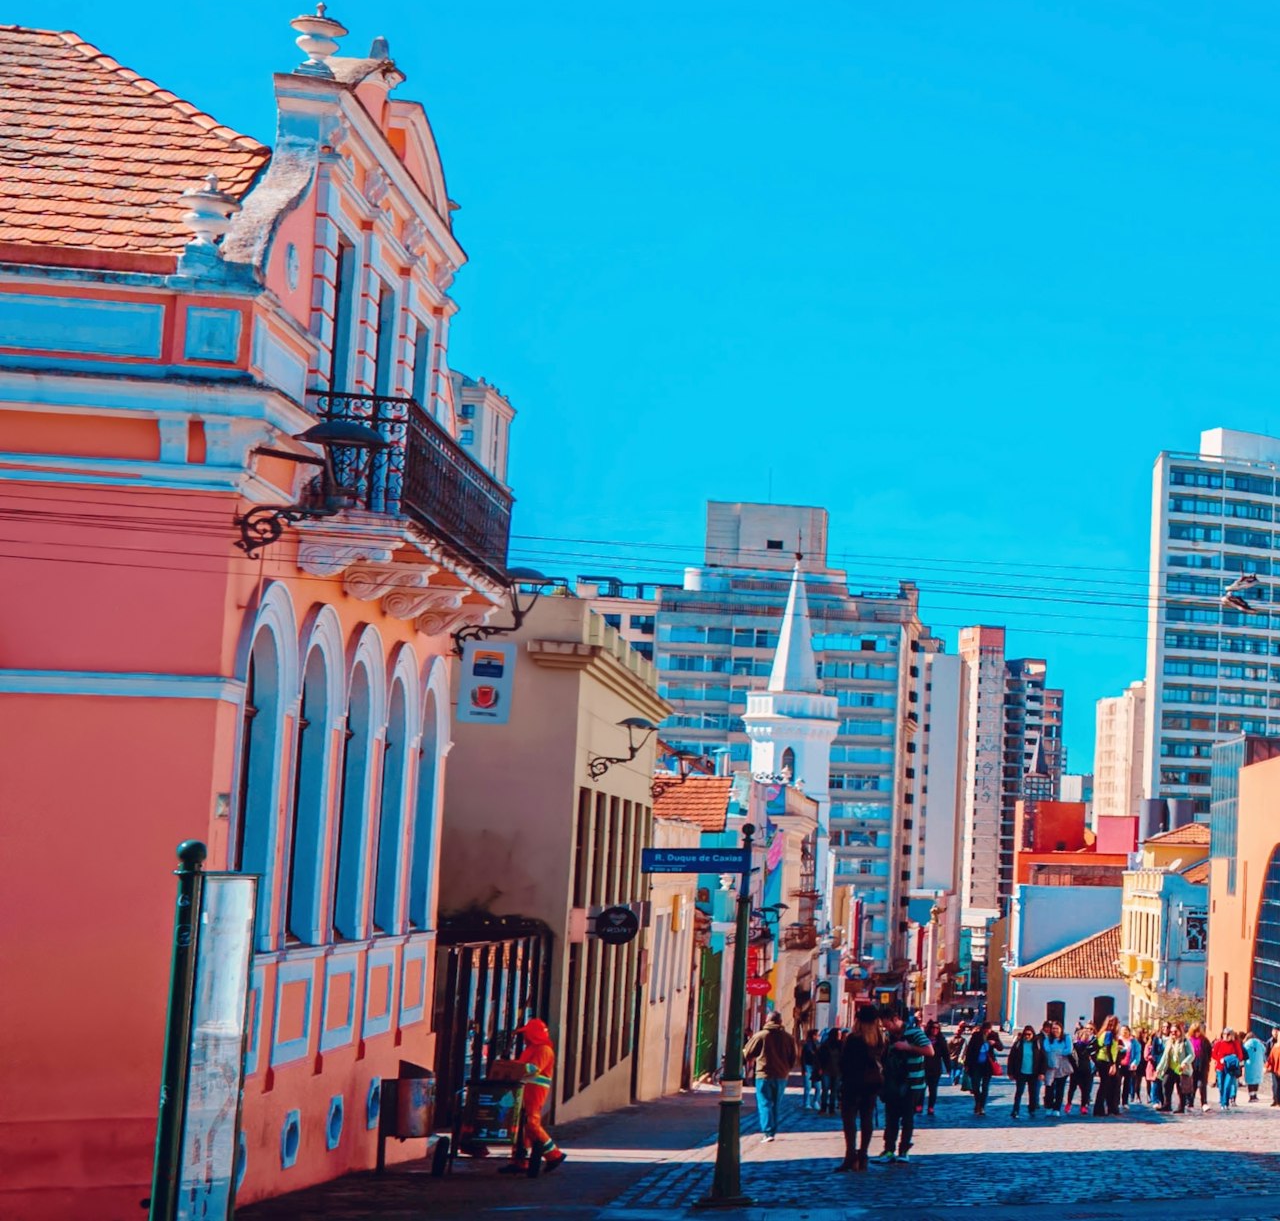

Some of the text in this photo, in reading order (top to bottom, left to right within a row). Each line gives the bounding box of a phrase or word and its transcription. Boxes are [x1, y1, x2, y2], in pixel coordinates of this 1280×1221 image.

[654, 853, 743, 863] R. Duque de Caxias
